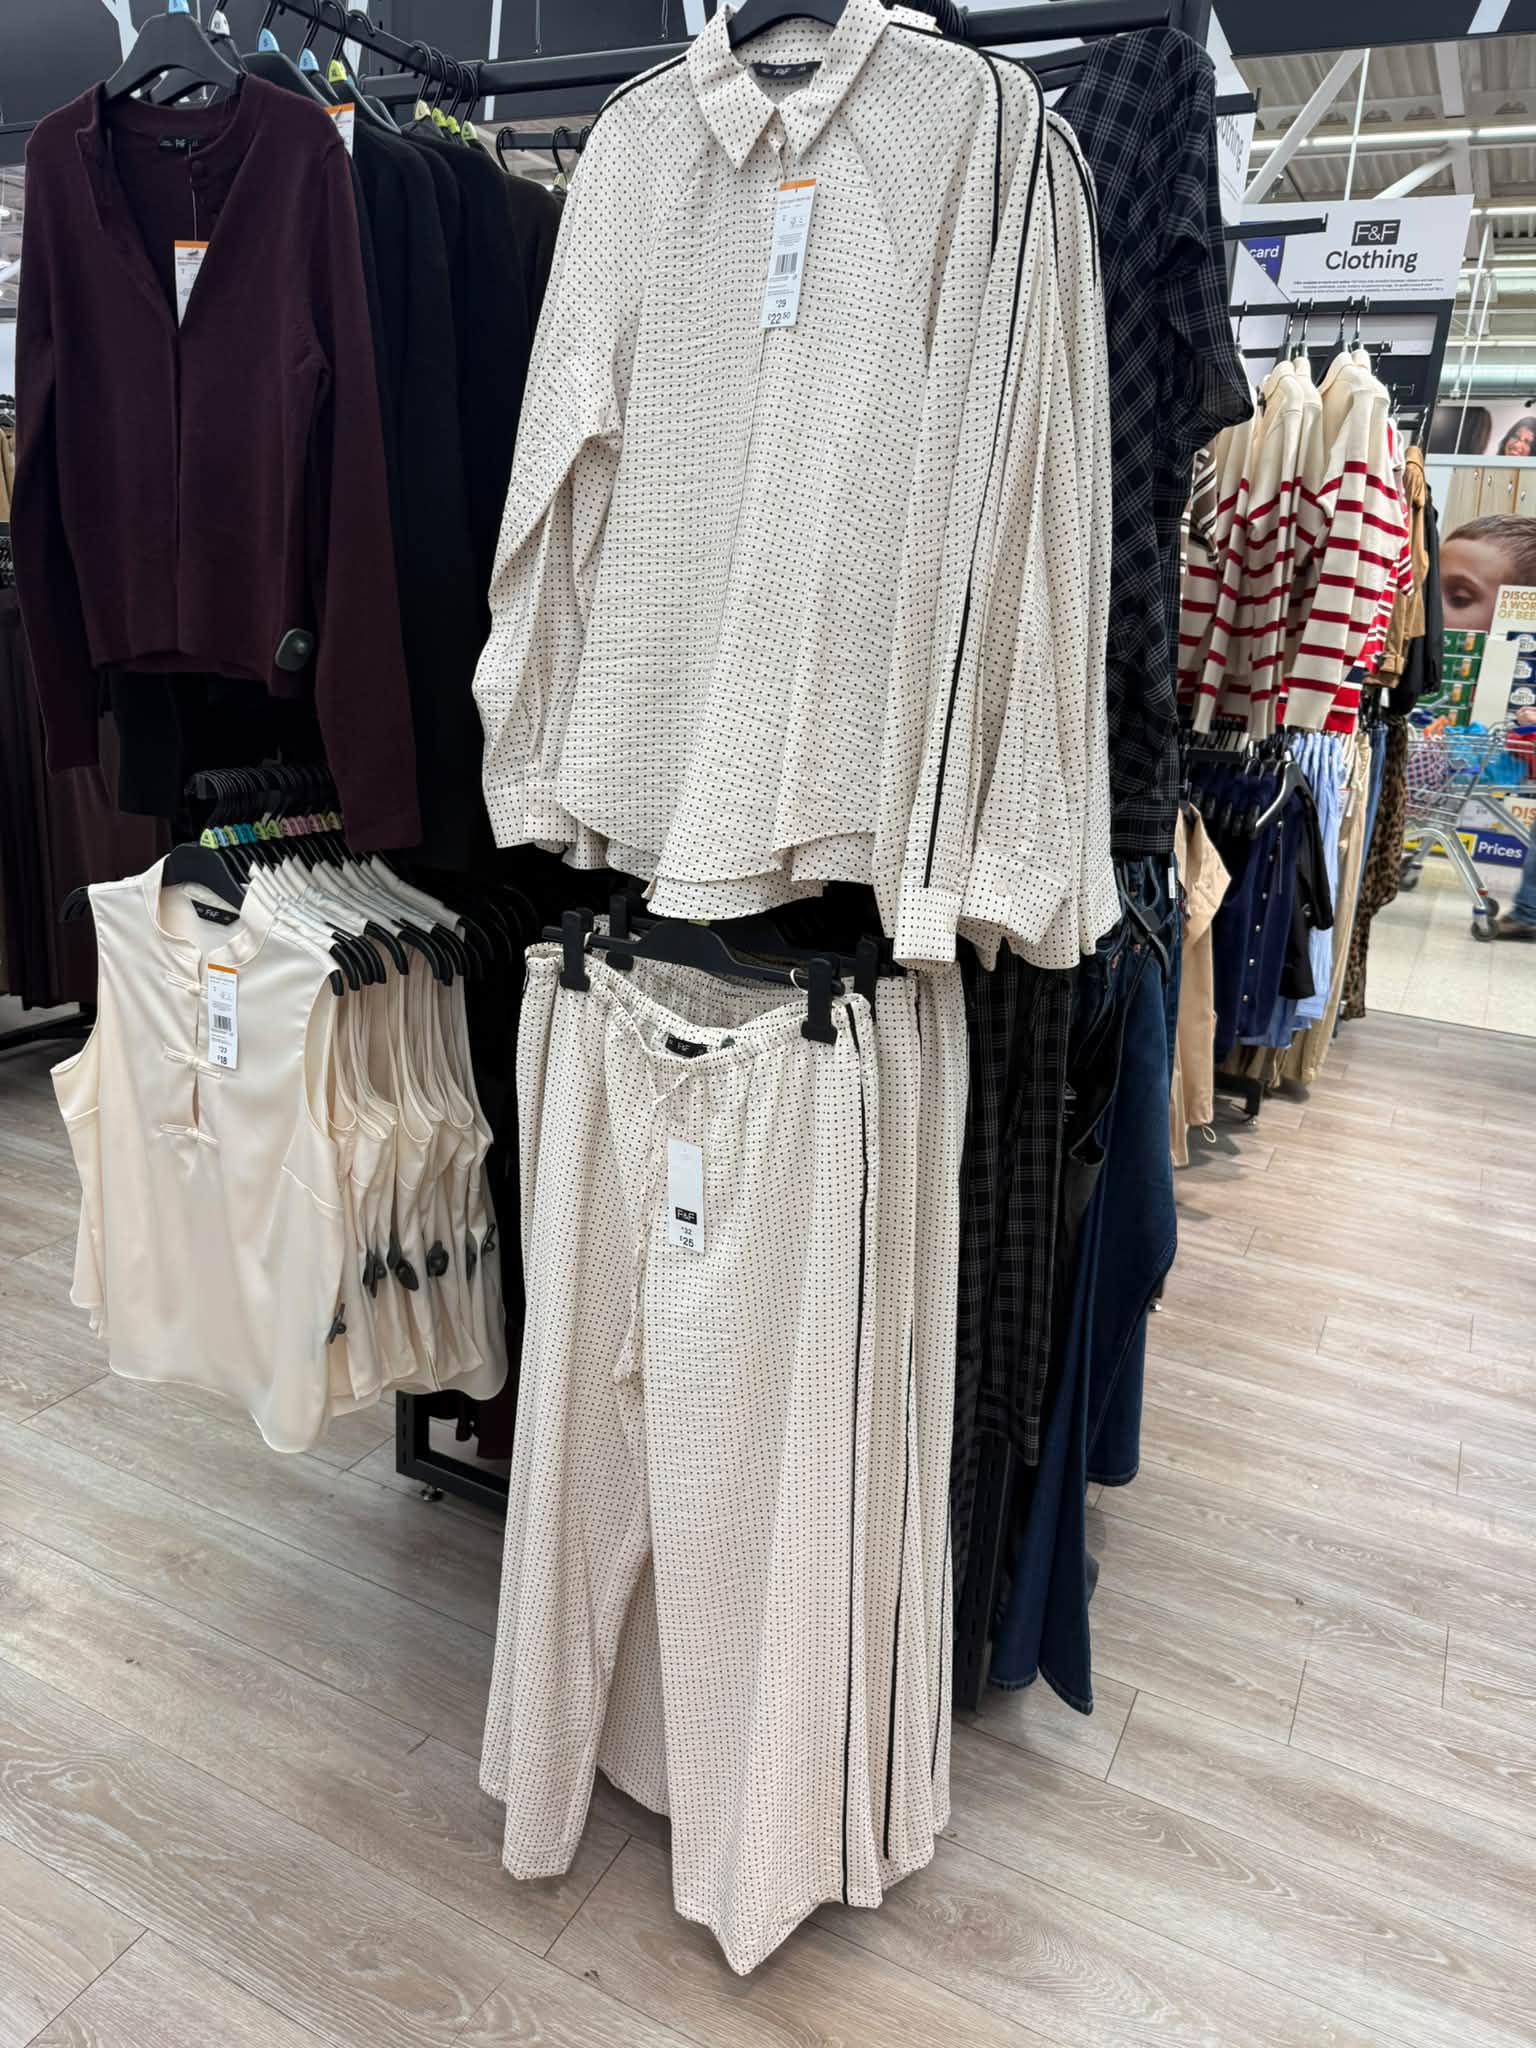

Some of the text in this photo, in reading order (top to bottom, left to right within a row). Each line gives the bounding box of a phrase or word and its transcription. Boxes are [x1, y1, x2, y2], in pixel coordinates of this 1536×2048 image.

[1354, 223, 1398, 243] F&F
[1325, 248, 1418, 273] Clothing
[1478, 841, 1522, 858] Prices
